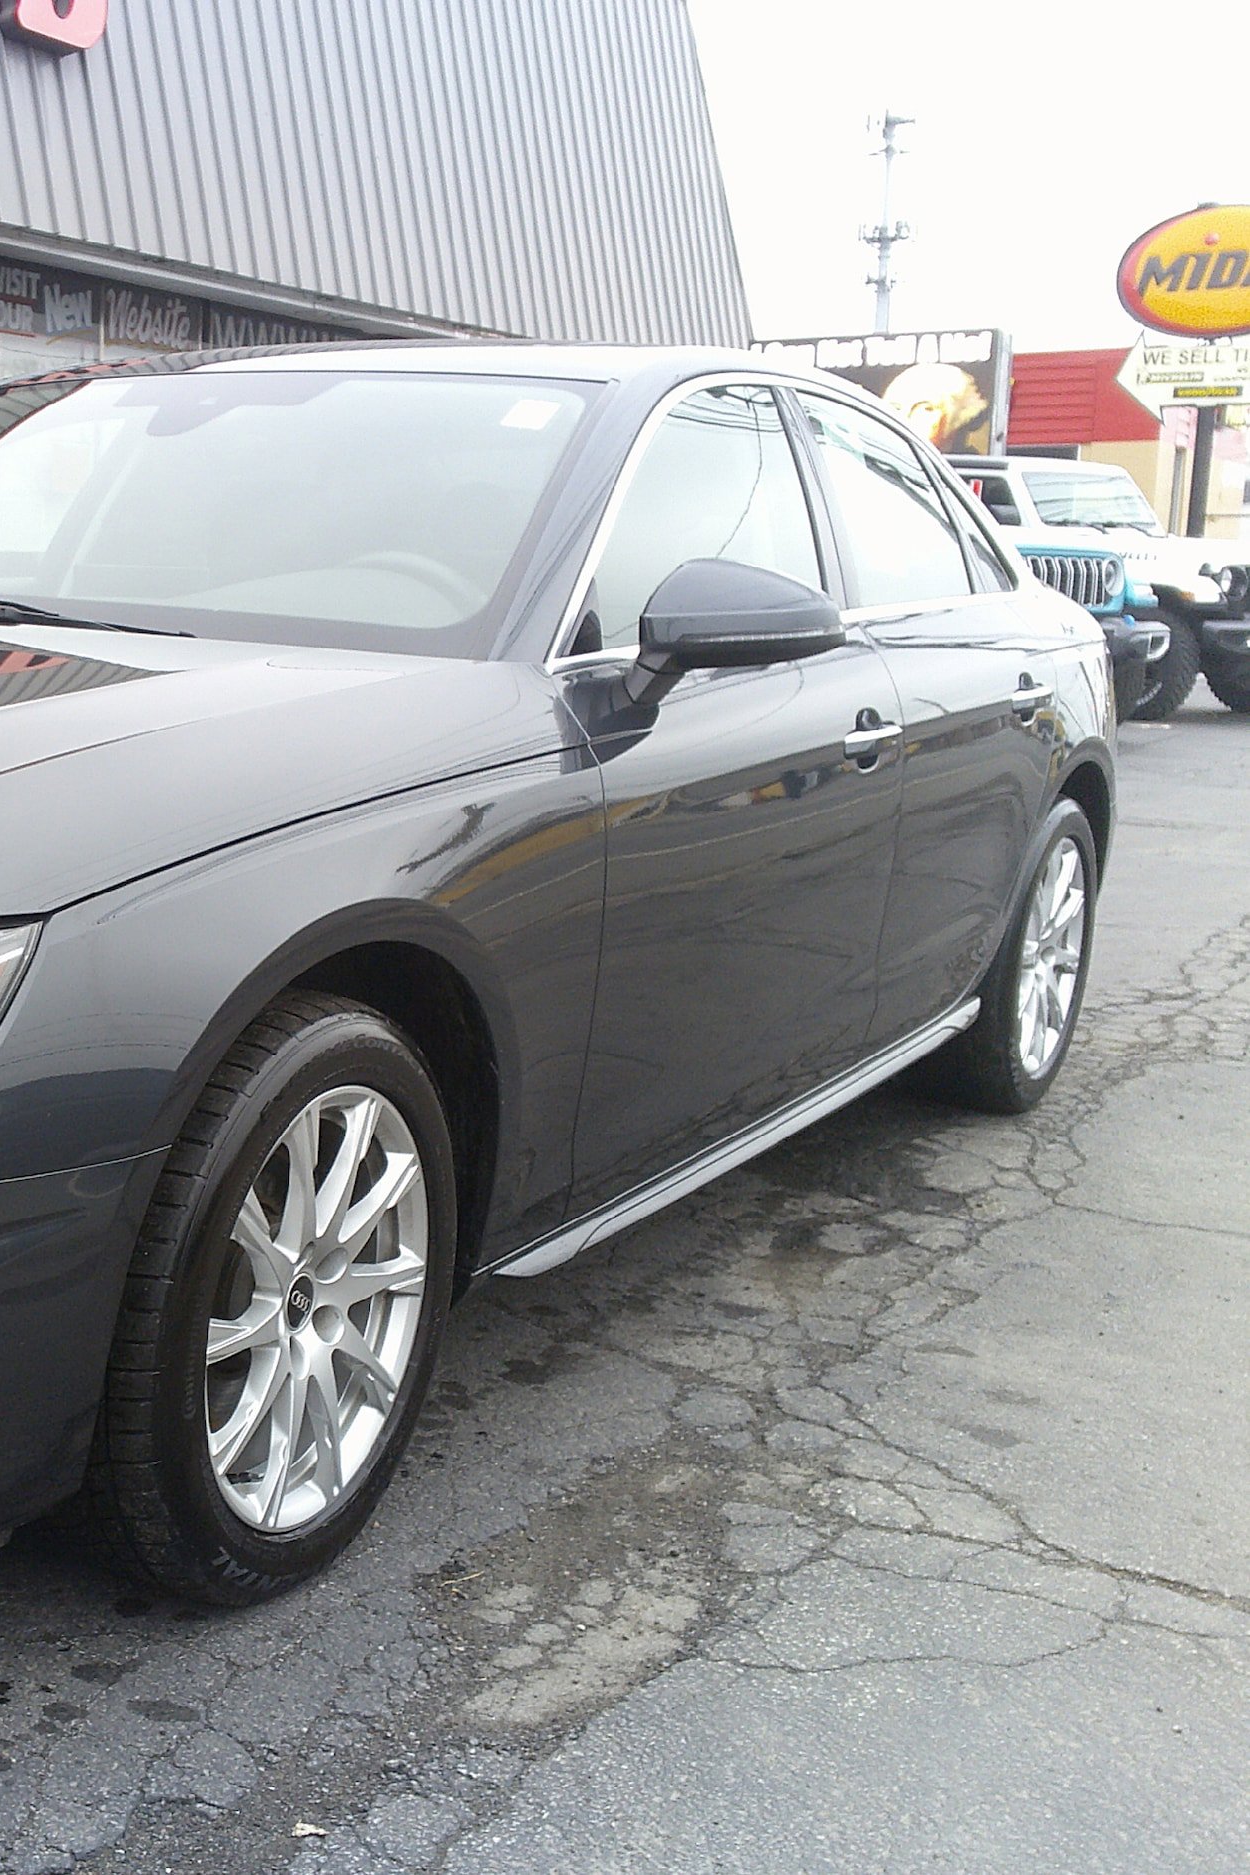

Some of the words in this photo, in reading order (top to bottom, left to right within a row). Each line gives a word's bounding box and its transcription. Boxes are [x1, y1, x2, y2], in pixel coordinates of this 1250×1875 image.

[1138, 249, 1250, 298] MID
[106, 288, 191, 350] Website
[1143, 351, 1170, 365] WE
[1179, 349, 1225, 365] SELL
[1234, 348, 1250, 363] TI
